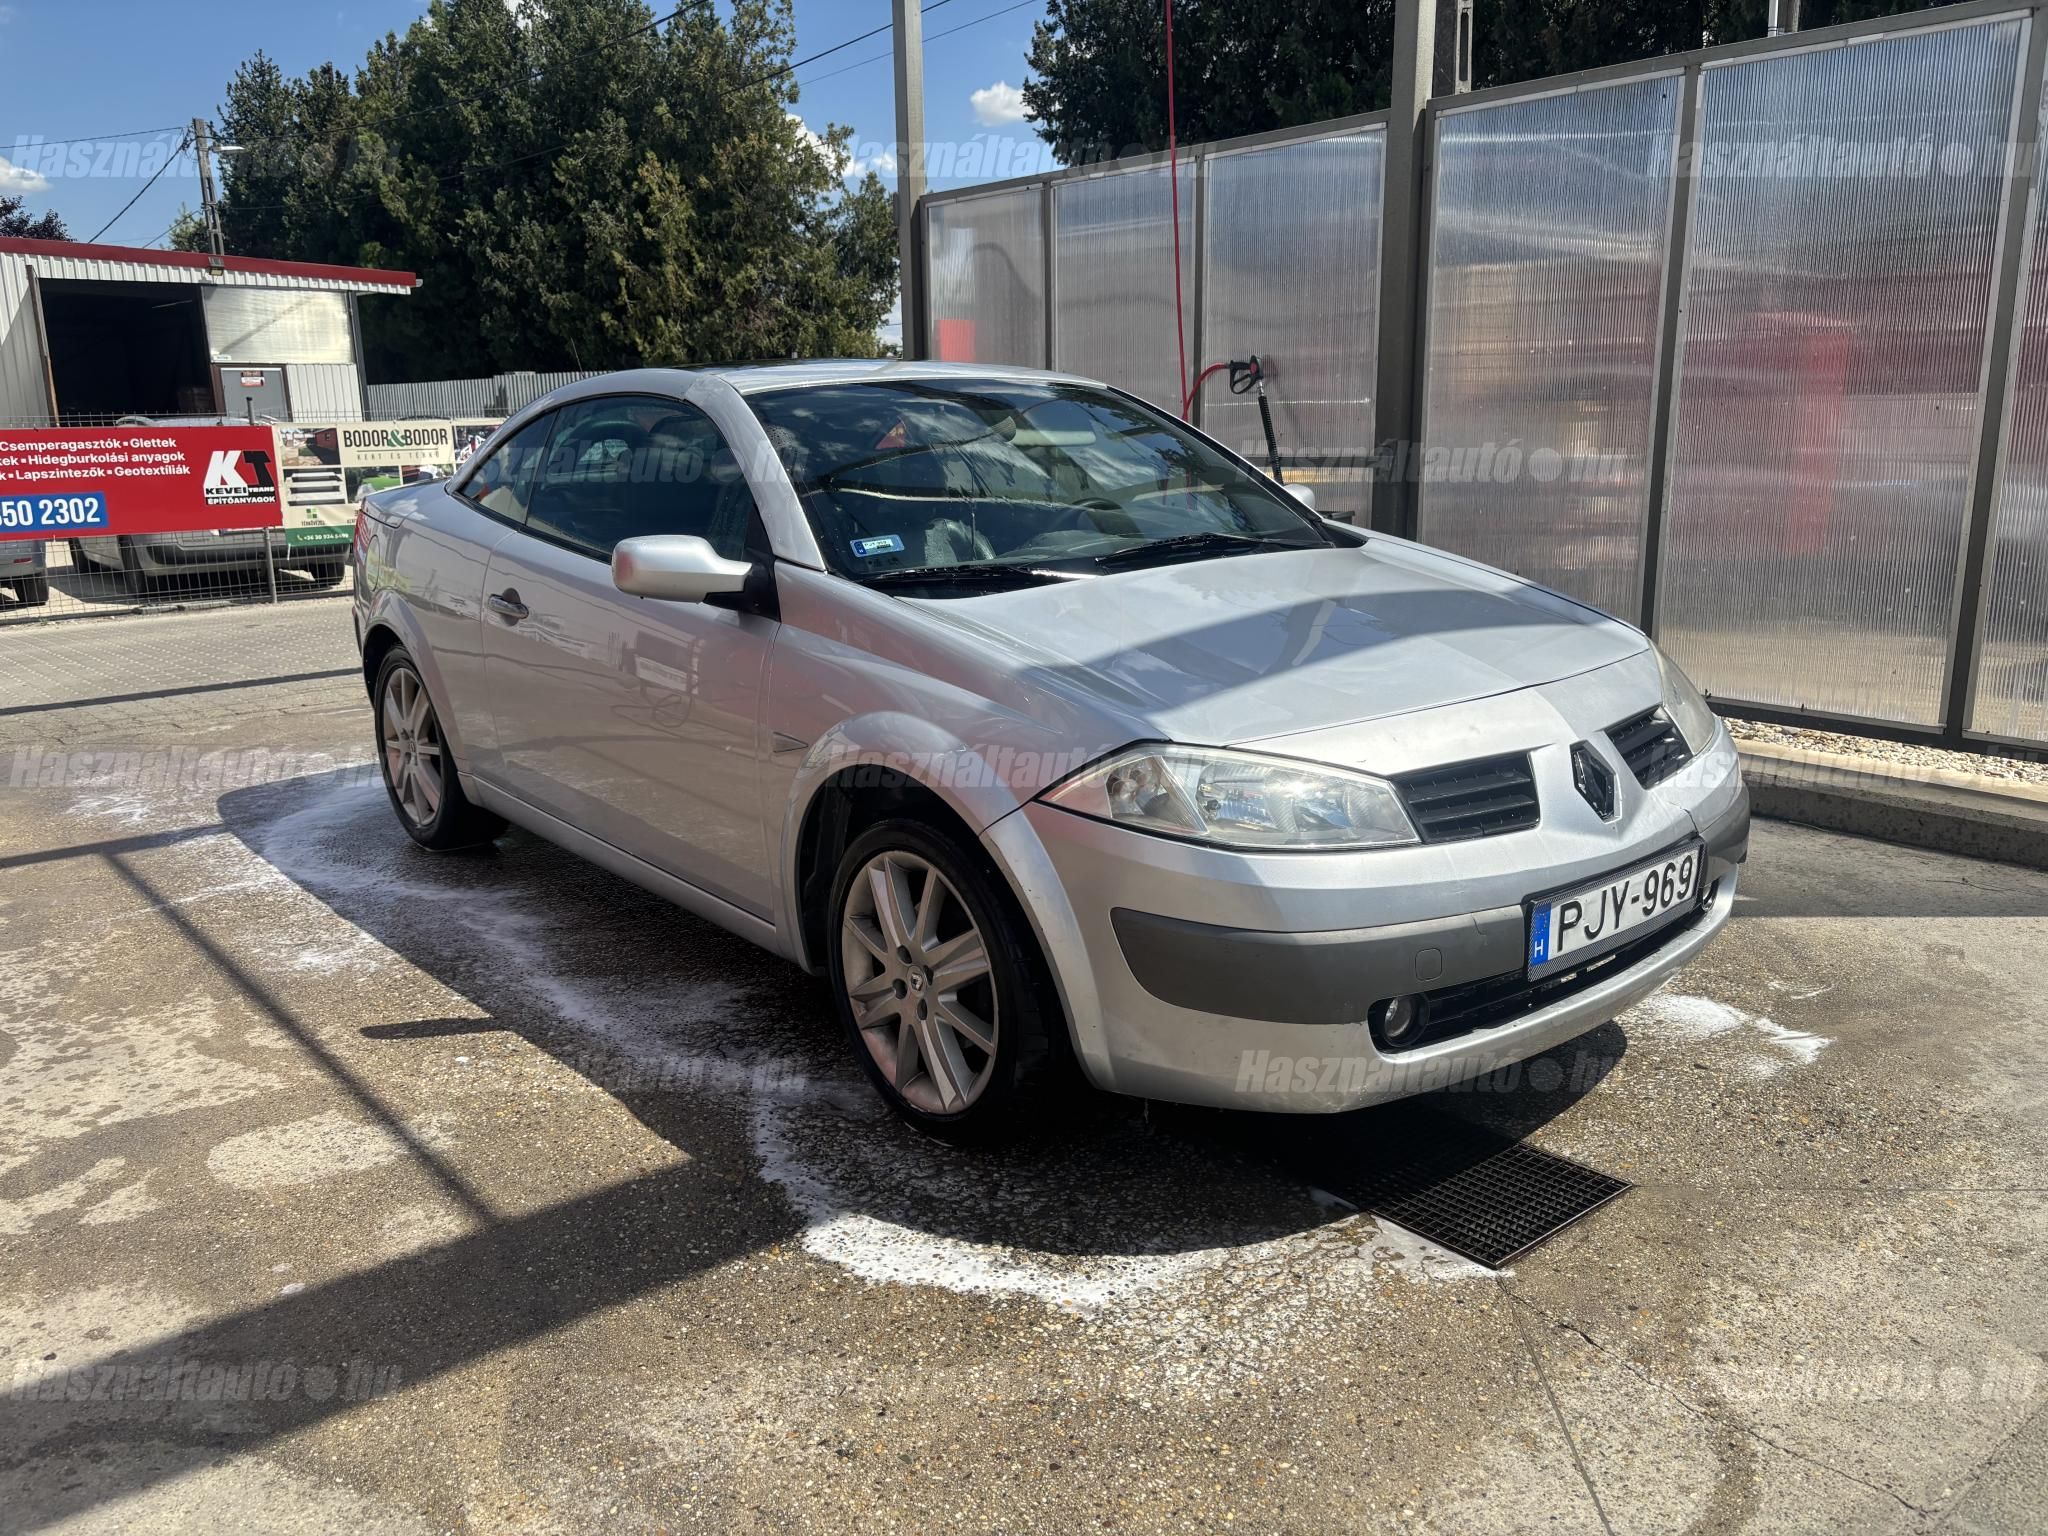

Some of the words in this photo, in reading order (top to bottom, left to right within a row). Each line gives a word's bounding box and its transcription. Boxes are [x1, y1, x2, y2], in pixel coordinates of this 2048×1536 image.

[0, 438, 121, 452] Csemperagasztók
[130, 437, 176, 448] Glettek
[343, 428, 449, 447] BODOR&BODOR
[29, 452, 128, 466] Hidegburkolási
[131, 451, 186, 464] anyagok
[16, 467, 105, 481] Lapszintezők
[114, 465, 190, 477] Geotextíliák
[205, 487, 247, 495] KEVEI
[207, 496, 276, 505] ÉPÍTŐANYAGOK
[0, 500, 34, 527] 50
[38, 497, 100, 525] 2302
[1556, 854, 1693, 953] PJY-969
[1534, 938, 1544, 958] H
